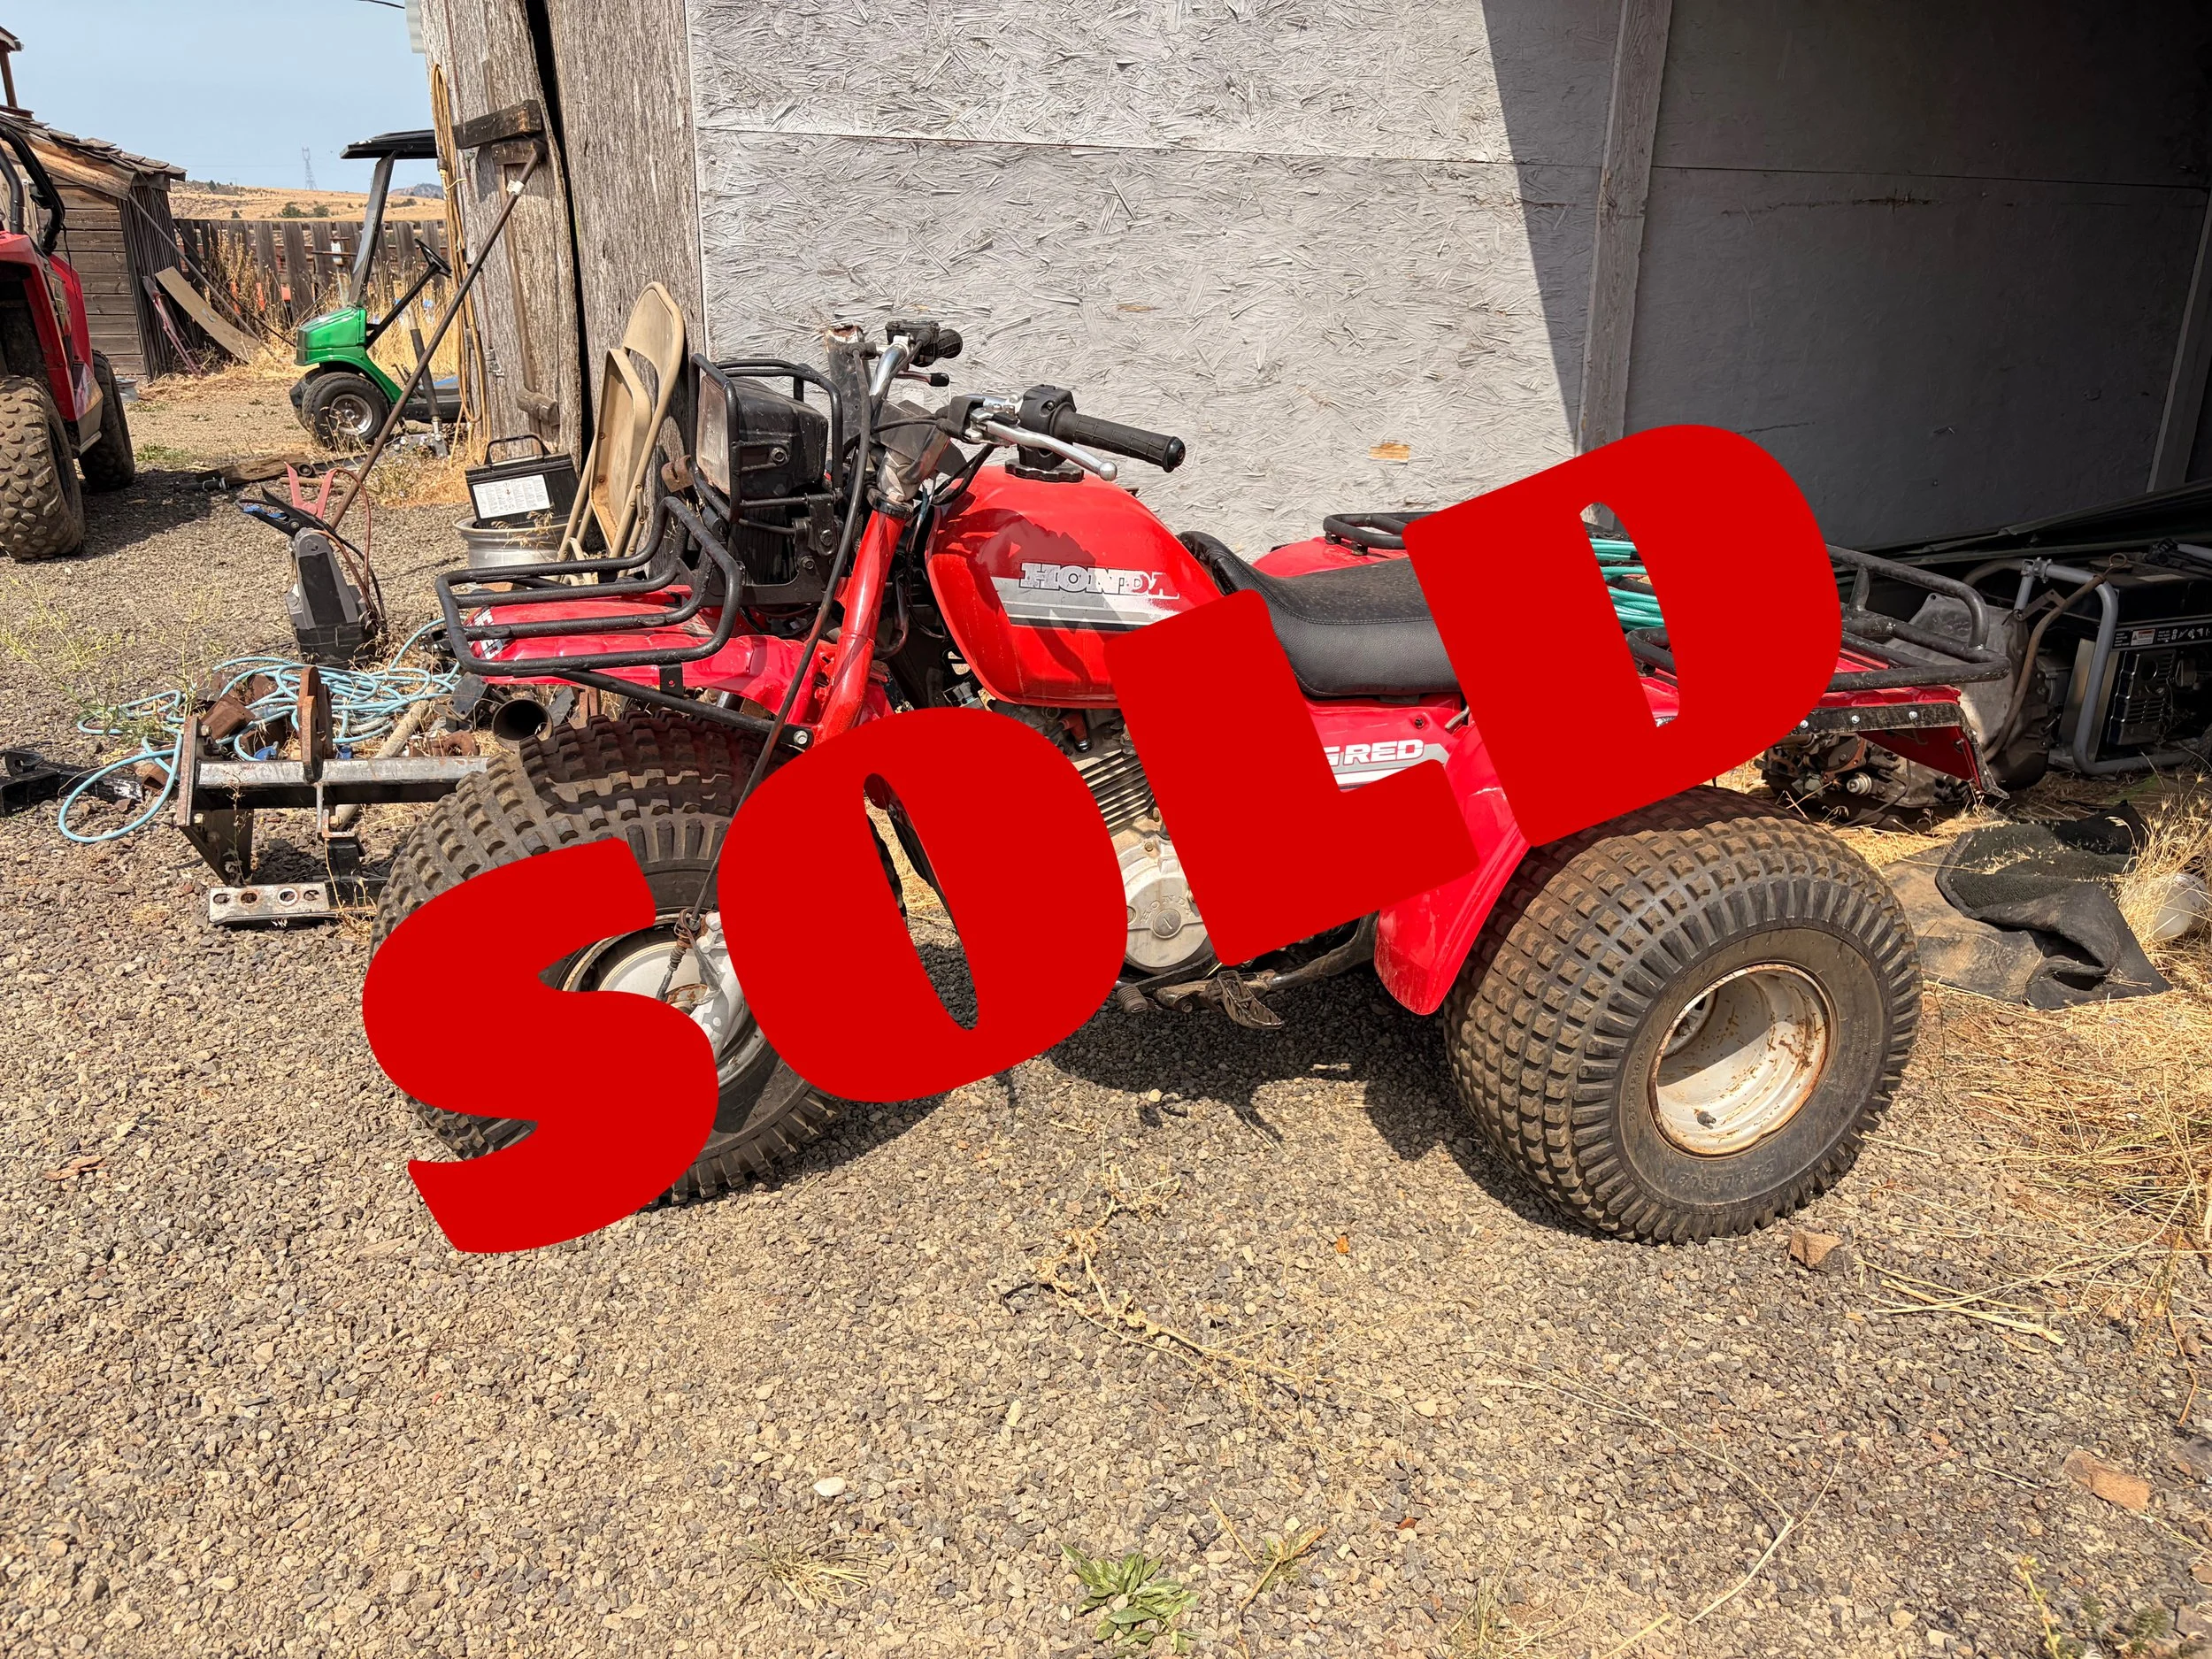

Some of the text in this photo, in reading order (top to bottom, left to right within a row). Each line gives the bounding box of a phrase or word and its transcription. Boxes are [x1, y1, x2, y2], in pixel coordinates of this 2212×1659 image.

[1018, 563, 1180, 600] HONDA
[1344, 739, 1425, 766] RED
[1140, 895, 1194, 924] HONDA
